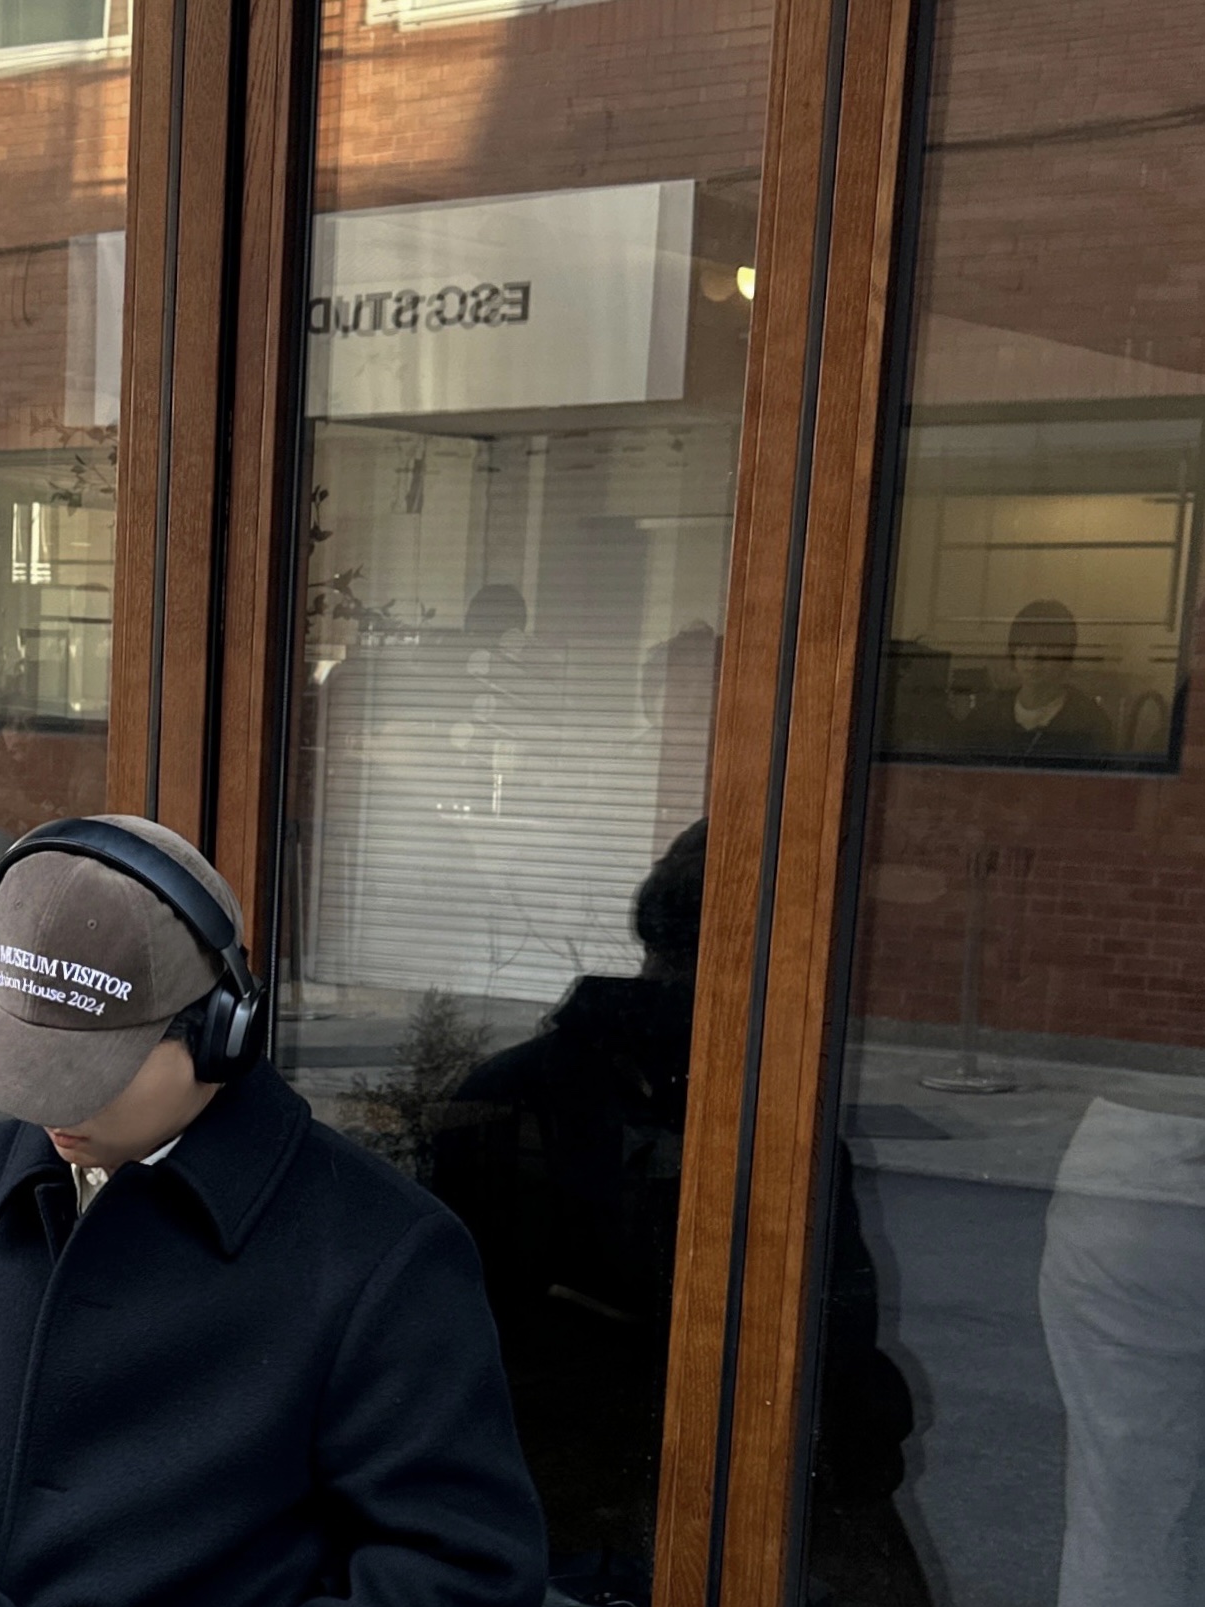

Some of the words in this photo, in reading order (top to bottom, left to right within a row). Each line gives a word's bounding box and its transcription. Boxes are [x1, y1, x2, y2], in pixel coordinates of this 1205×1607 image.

[0, 945, 59, 977] MUSEUM
[61, 960, 133, 1001] VISITOR
[22, 978, 66, 1003] House
[67, 991, 105, 1017] 2024
